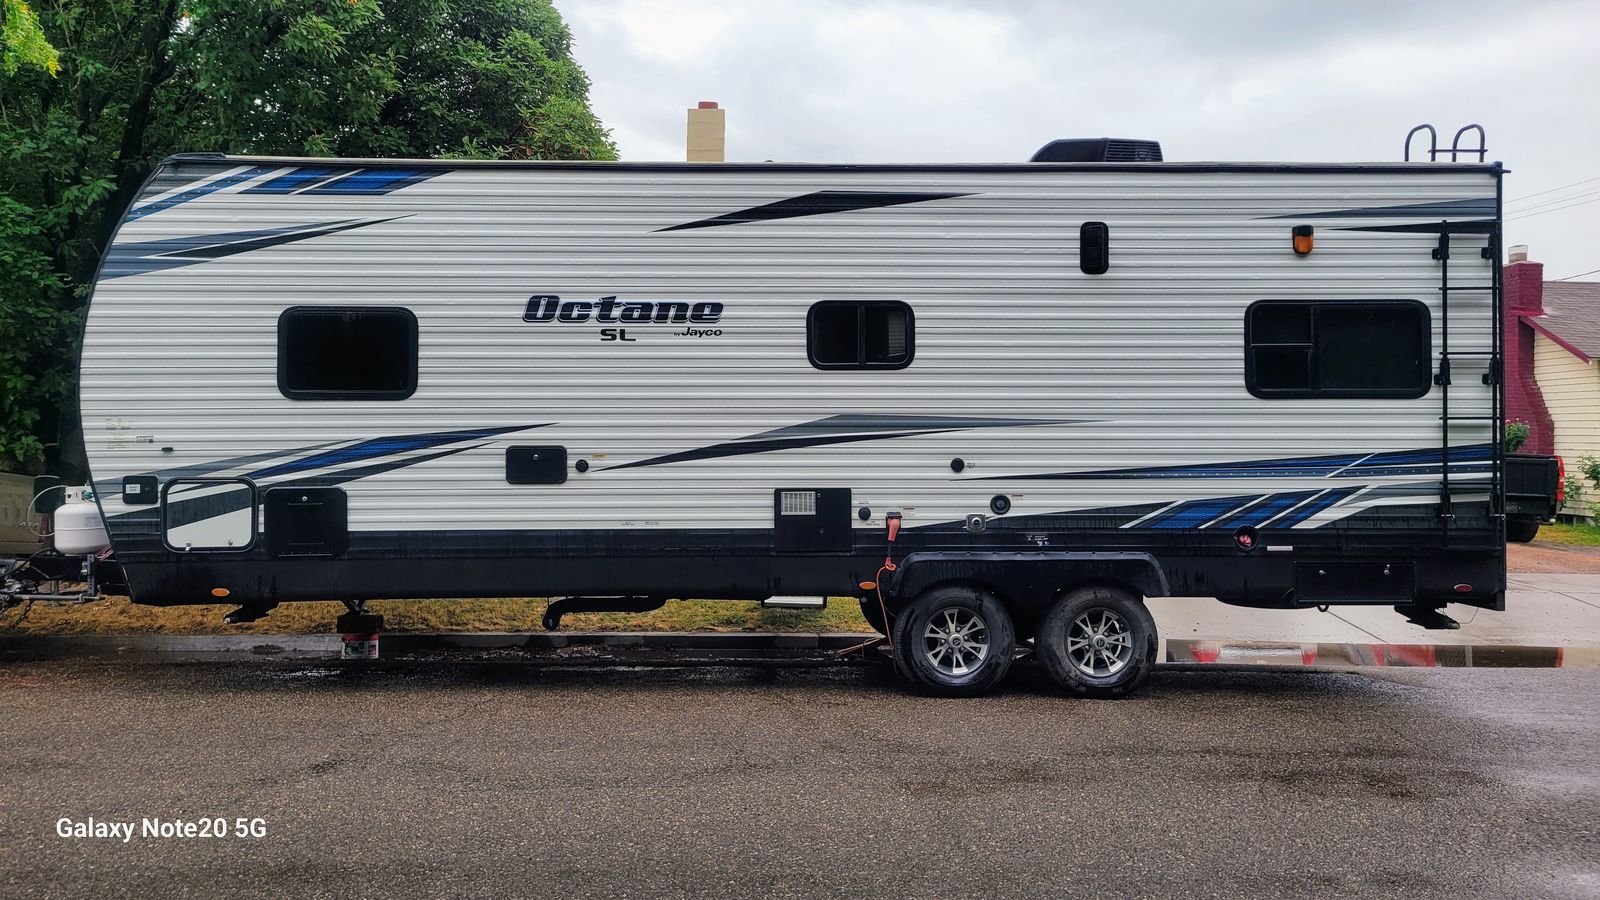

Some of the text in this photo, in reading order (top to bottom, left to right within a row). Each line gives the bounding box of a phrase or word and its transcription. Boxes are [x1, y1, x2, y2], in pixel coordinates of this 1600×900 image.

[522, 295, 724, 323] Octane
[601, 329, 636, 341] SL
[681, 326, 723, 338] Jayco
